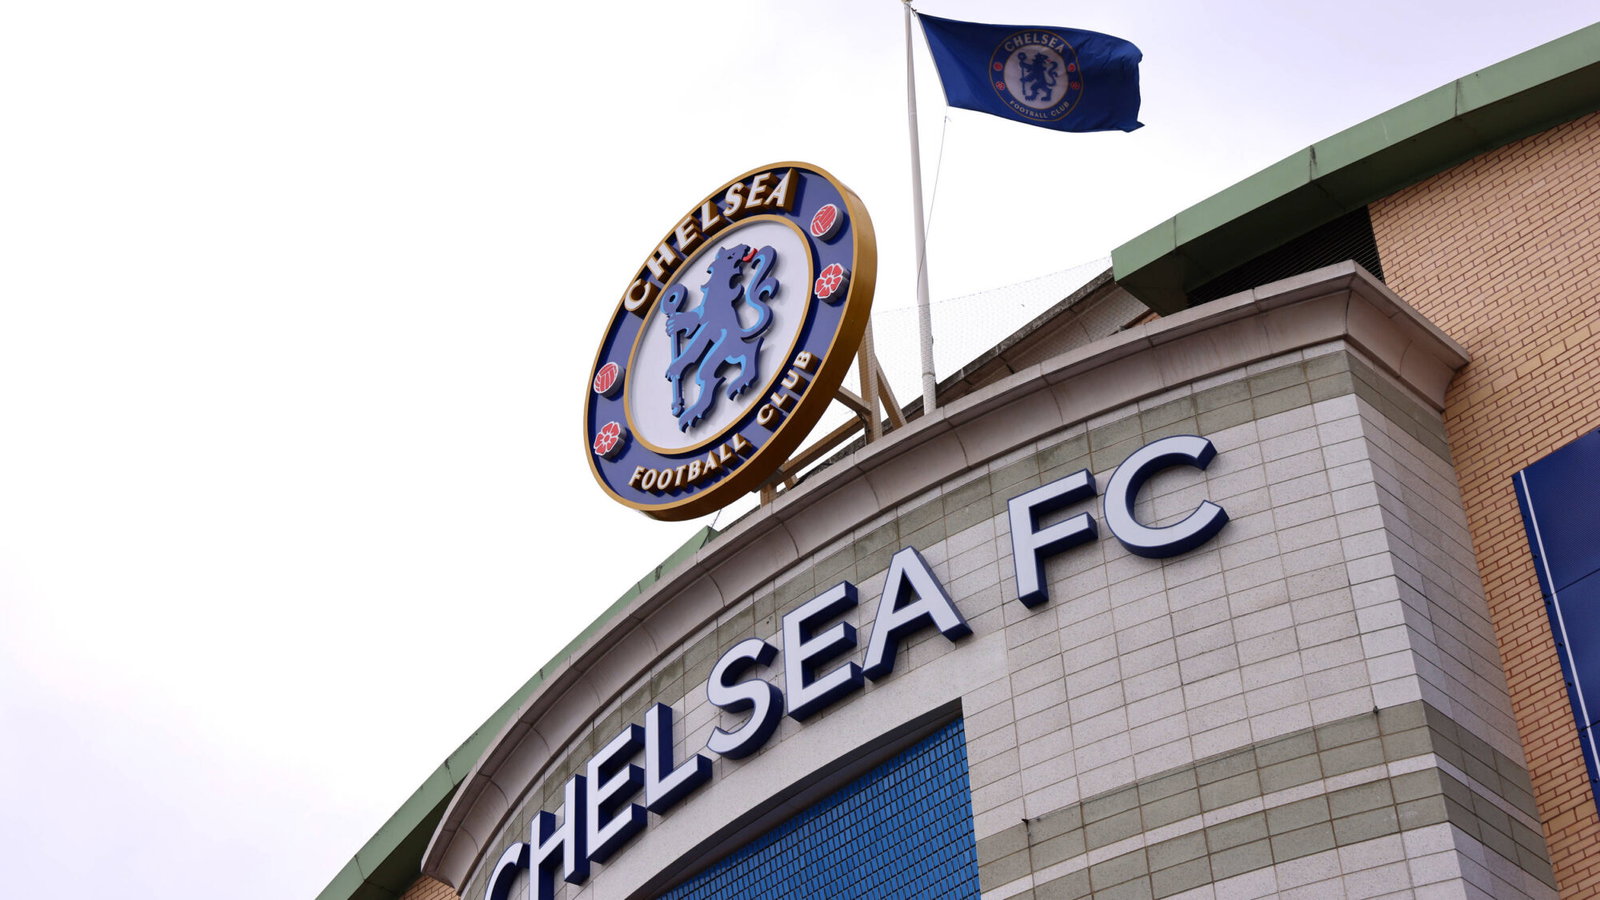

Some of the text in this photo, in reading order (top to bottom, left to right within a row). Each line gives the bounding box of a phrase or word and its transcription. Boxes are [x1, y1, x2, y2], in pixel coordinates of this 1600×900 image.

[1004, 32, 1065, 54] CHELSEA
[1009, 100, 1070, 118] FOOTBALL CLUB
[624, 168, 797, 317] CHELSEA
[628, 350, 819, 494] FOOTBALL CLUB
[1007, 435, 1230, 609] FC
